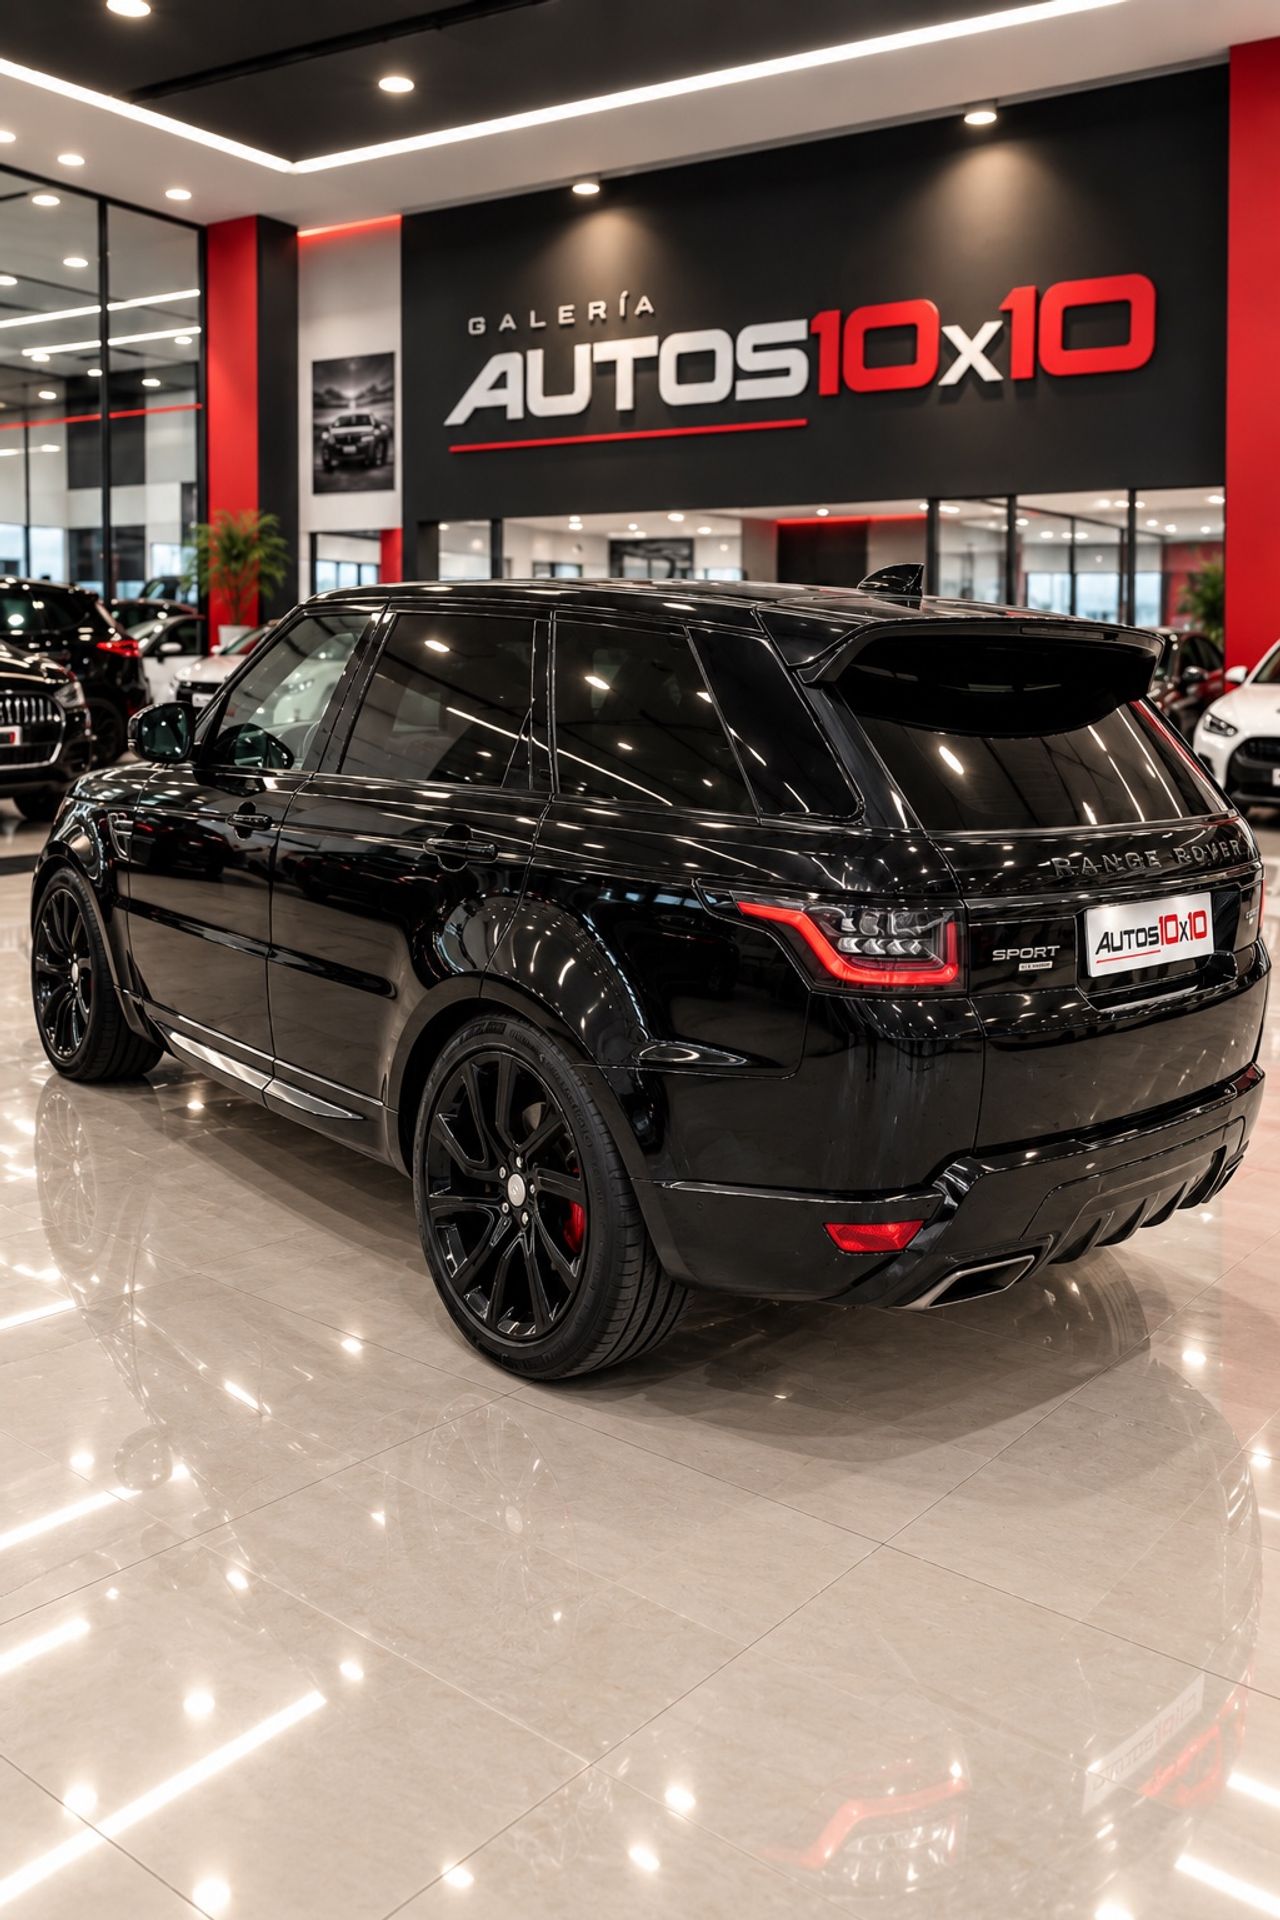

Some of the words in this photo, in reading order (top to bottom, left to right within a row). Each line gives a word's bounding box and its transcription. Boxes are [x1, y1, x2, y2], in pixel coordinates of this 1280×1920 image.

[468, 291, 655, 335] GALERÍA
[1051, 851, 1162, 876] RANGE
[992, 945, 1061, 962] SPORT
